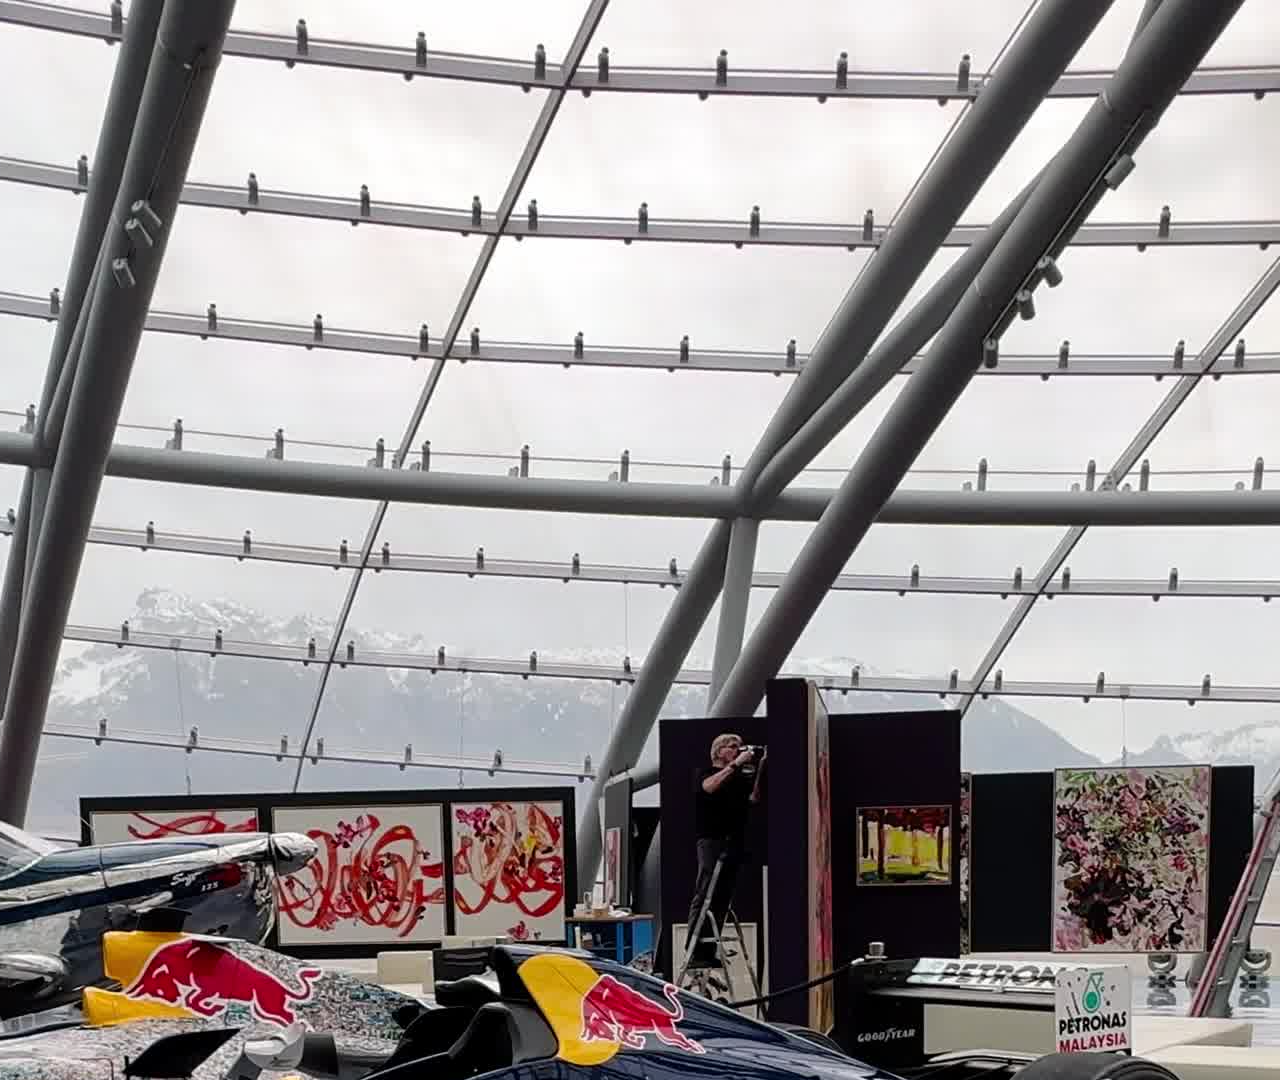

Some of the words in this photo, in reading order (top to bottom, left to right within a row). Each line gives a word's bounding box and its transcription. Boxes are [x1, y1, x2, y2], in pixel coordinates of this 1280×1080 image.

[940, 962, 1086, 989] PETRON
[1058, 1011, 1127, 1036] PETRONAS
[856, 1028, 916, 1042] GOODYEAR
[1058, 1033, 1128, 1053] MALAYSIA
